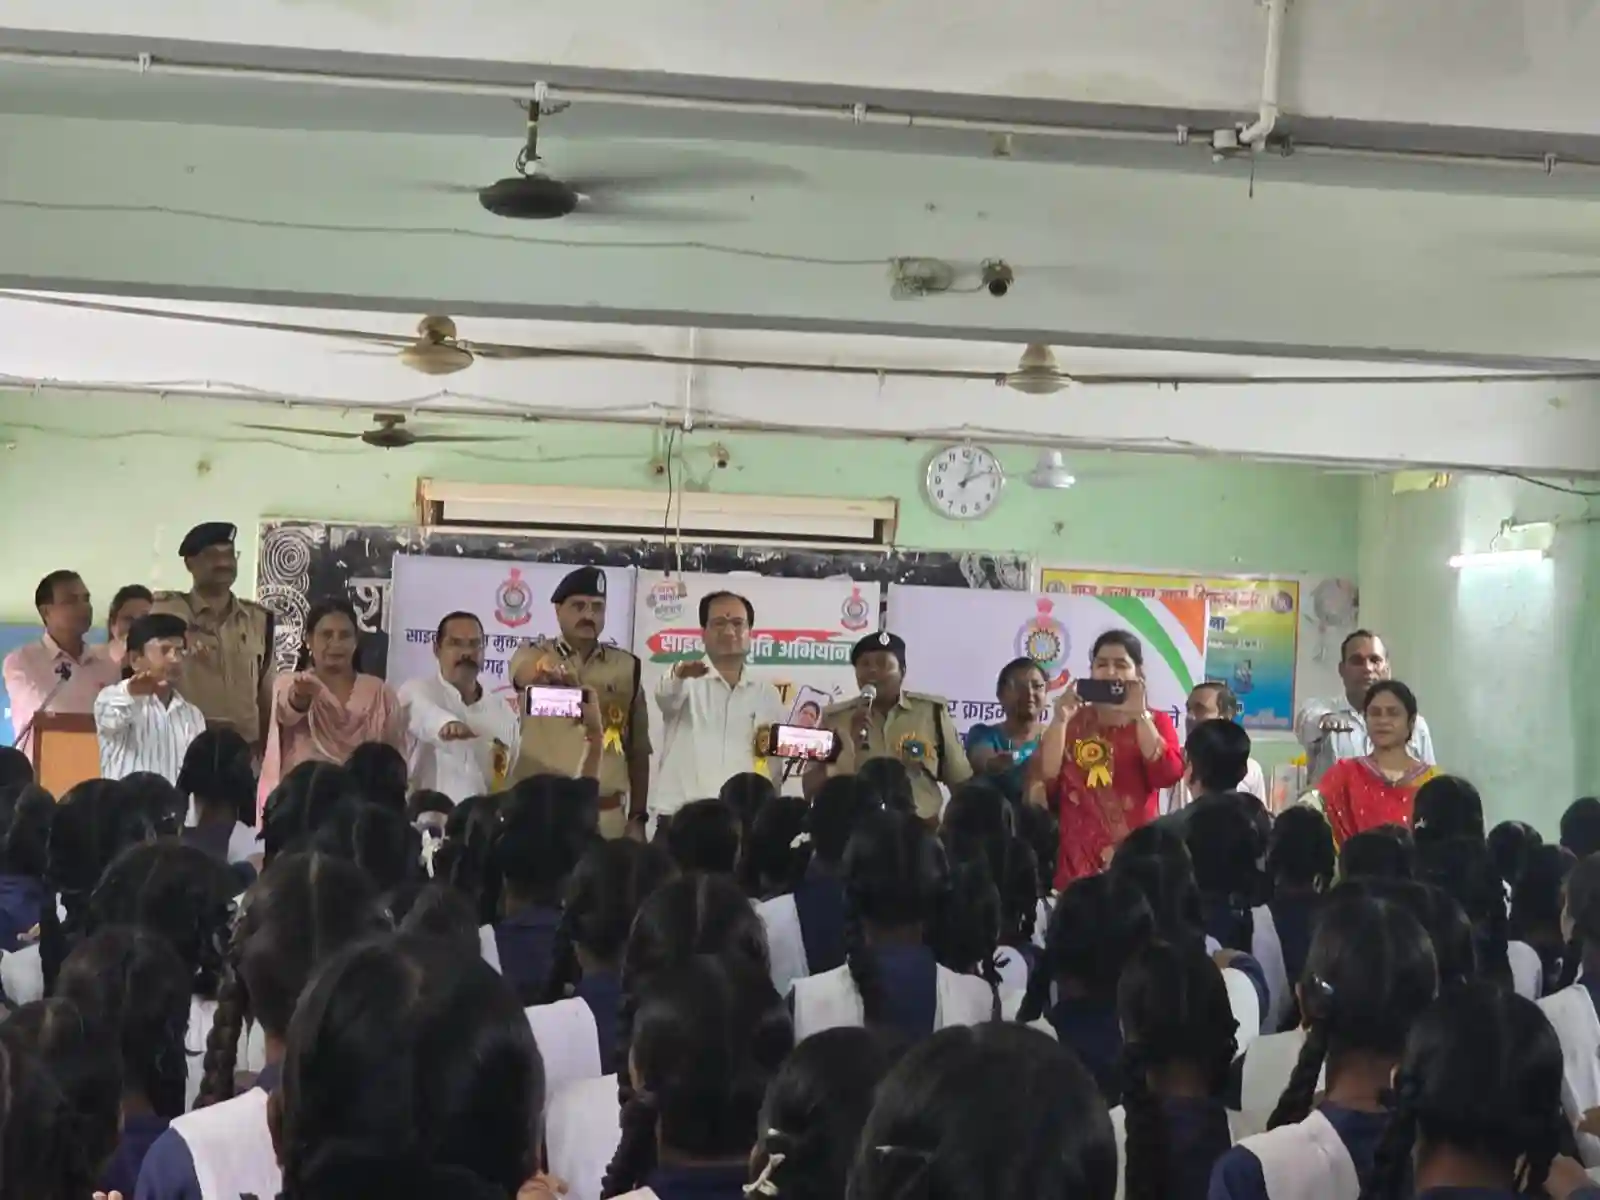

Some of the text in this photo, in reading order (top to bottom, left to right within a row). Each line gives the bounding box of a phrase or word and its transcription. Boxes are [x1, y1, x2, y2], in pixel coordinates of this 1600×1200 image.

[948, 452, 956, 463] 11
[938, 463, 948, 473] 10
[778, 637, 853, 661] अभियान
